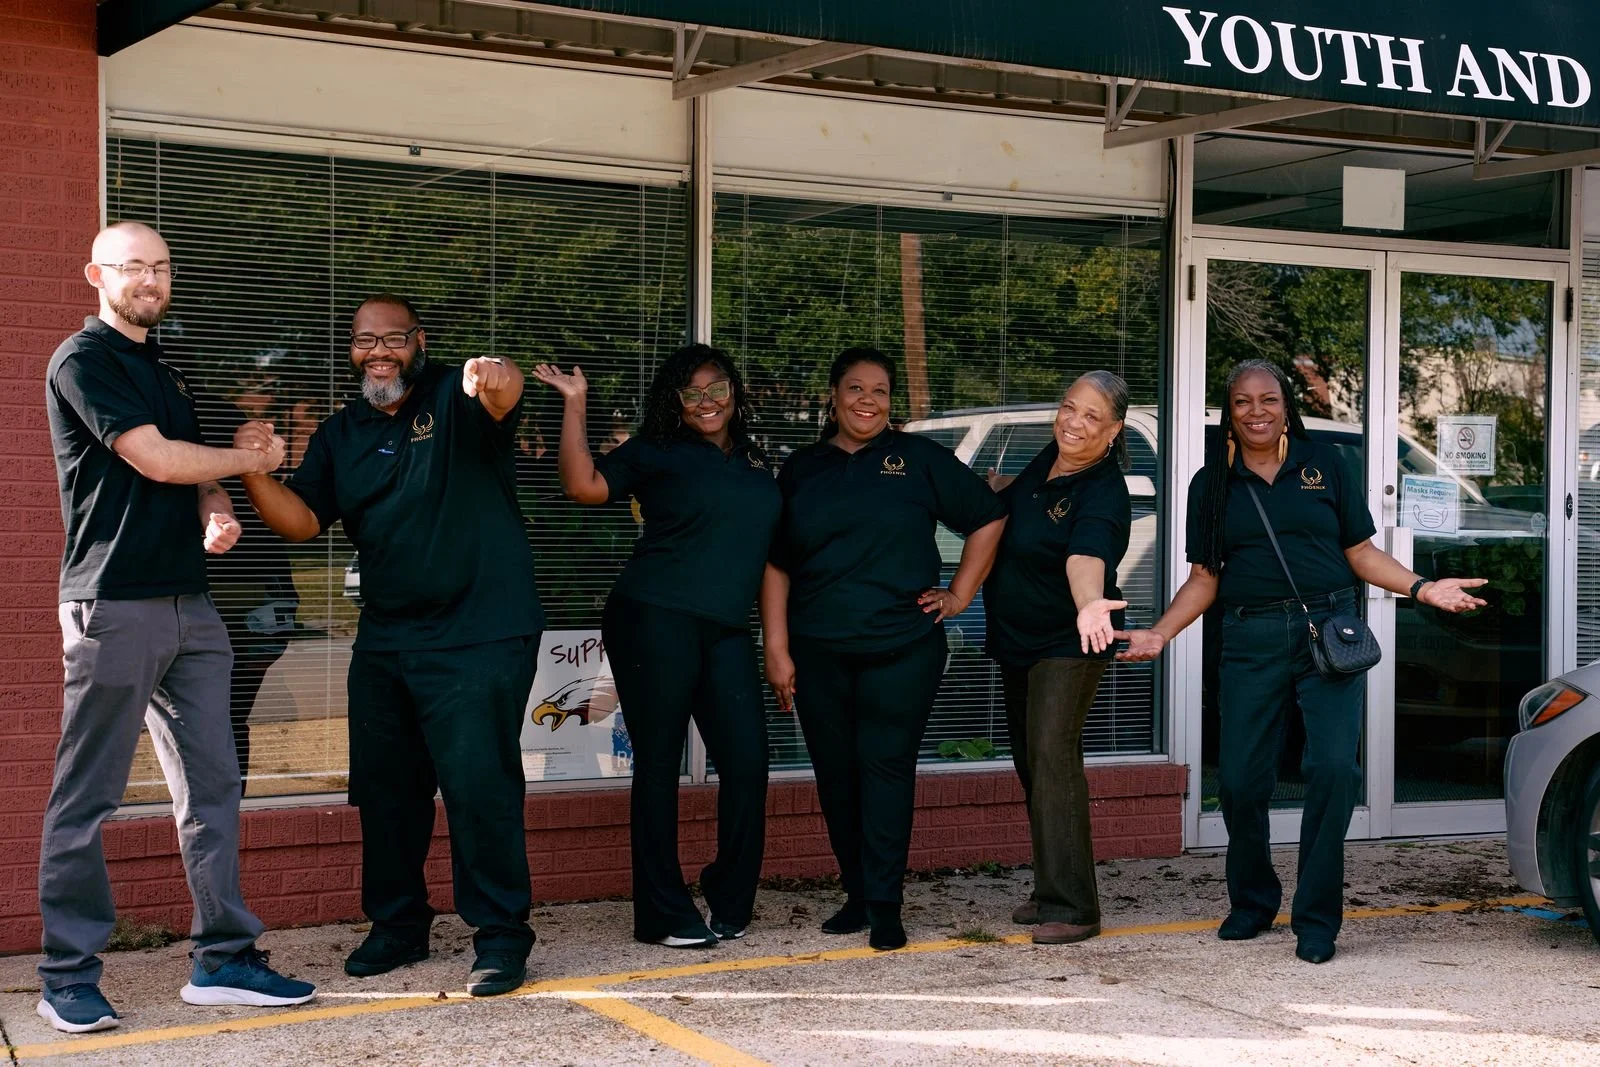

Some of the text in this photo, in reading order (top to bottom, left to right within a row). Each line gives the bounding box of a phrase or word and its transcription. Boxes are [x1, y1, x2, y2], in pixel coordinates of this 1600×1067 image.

[1162, 5, 1592, 109] YOUTH AND
[1444, 451, 1487, 460] NO SMOKING
[1406, 486, 1428, 495] Masks
